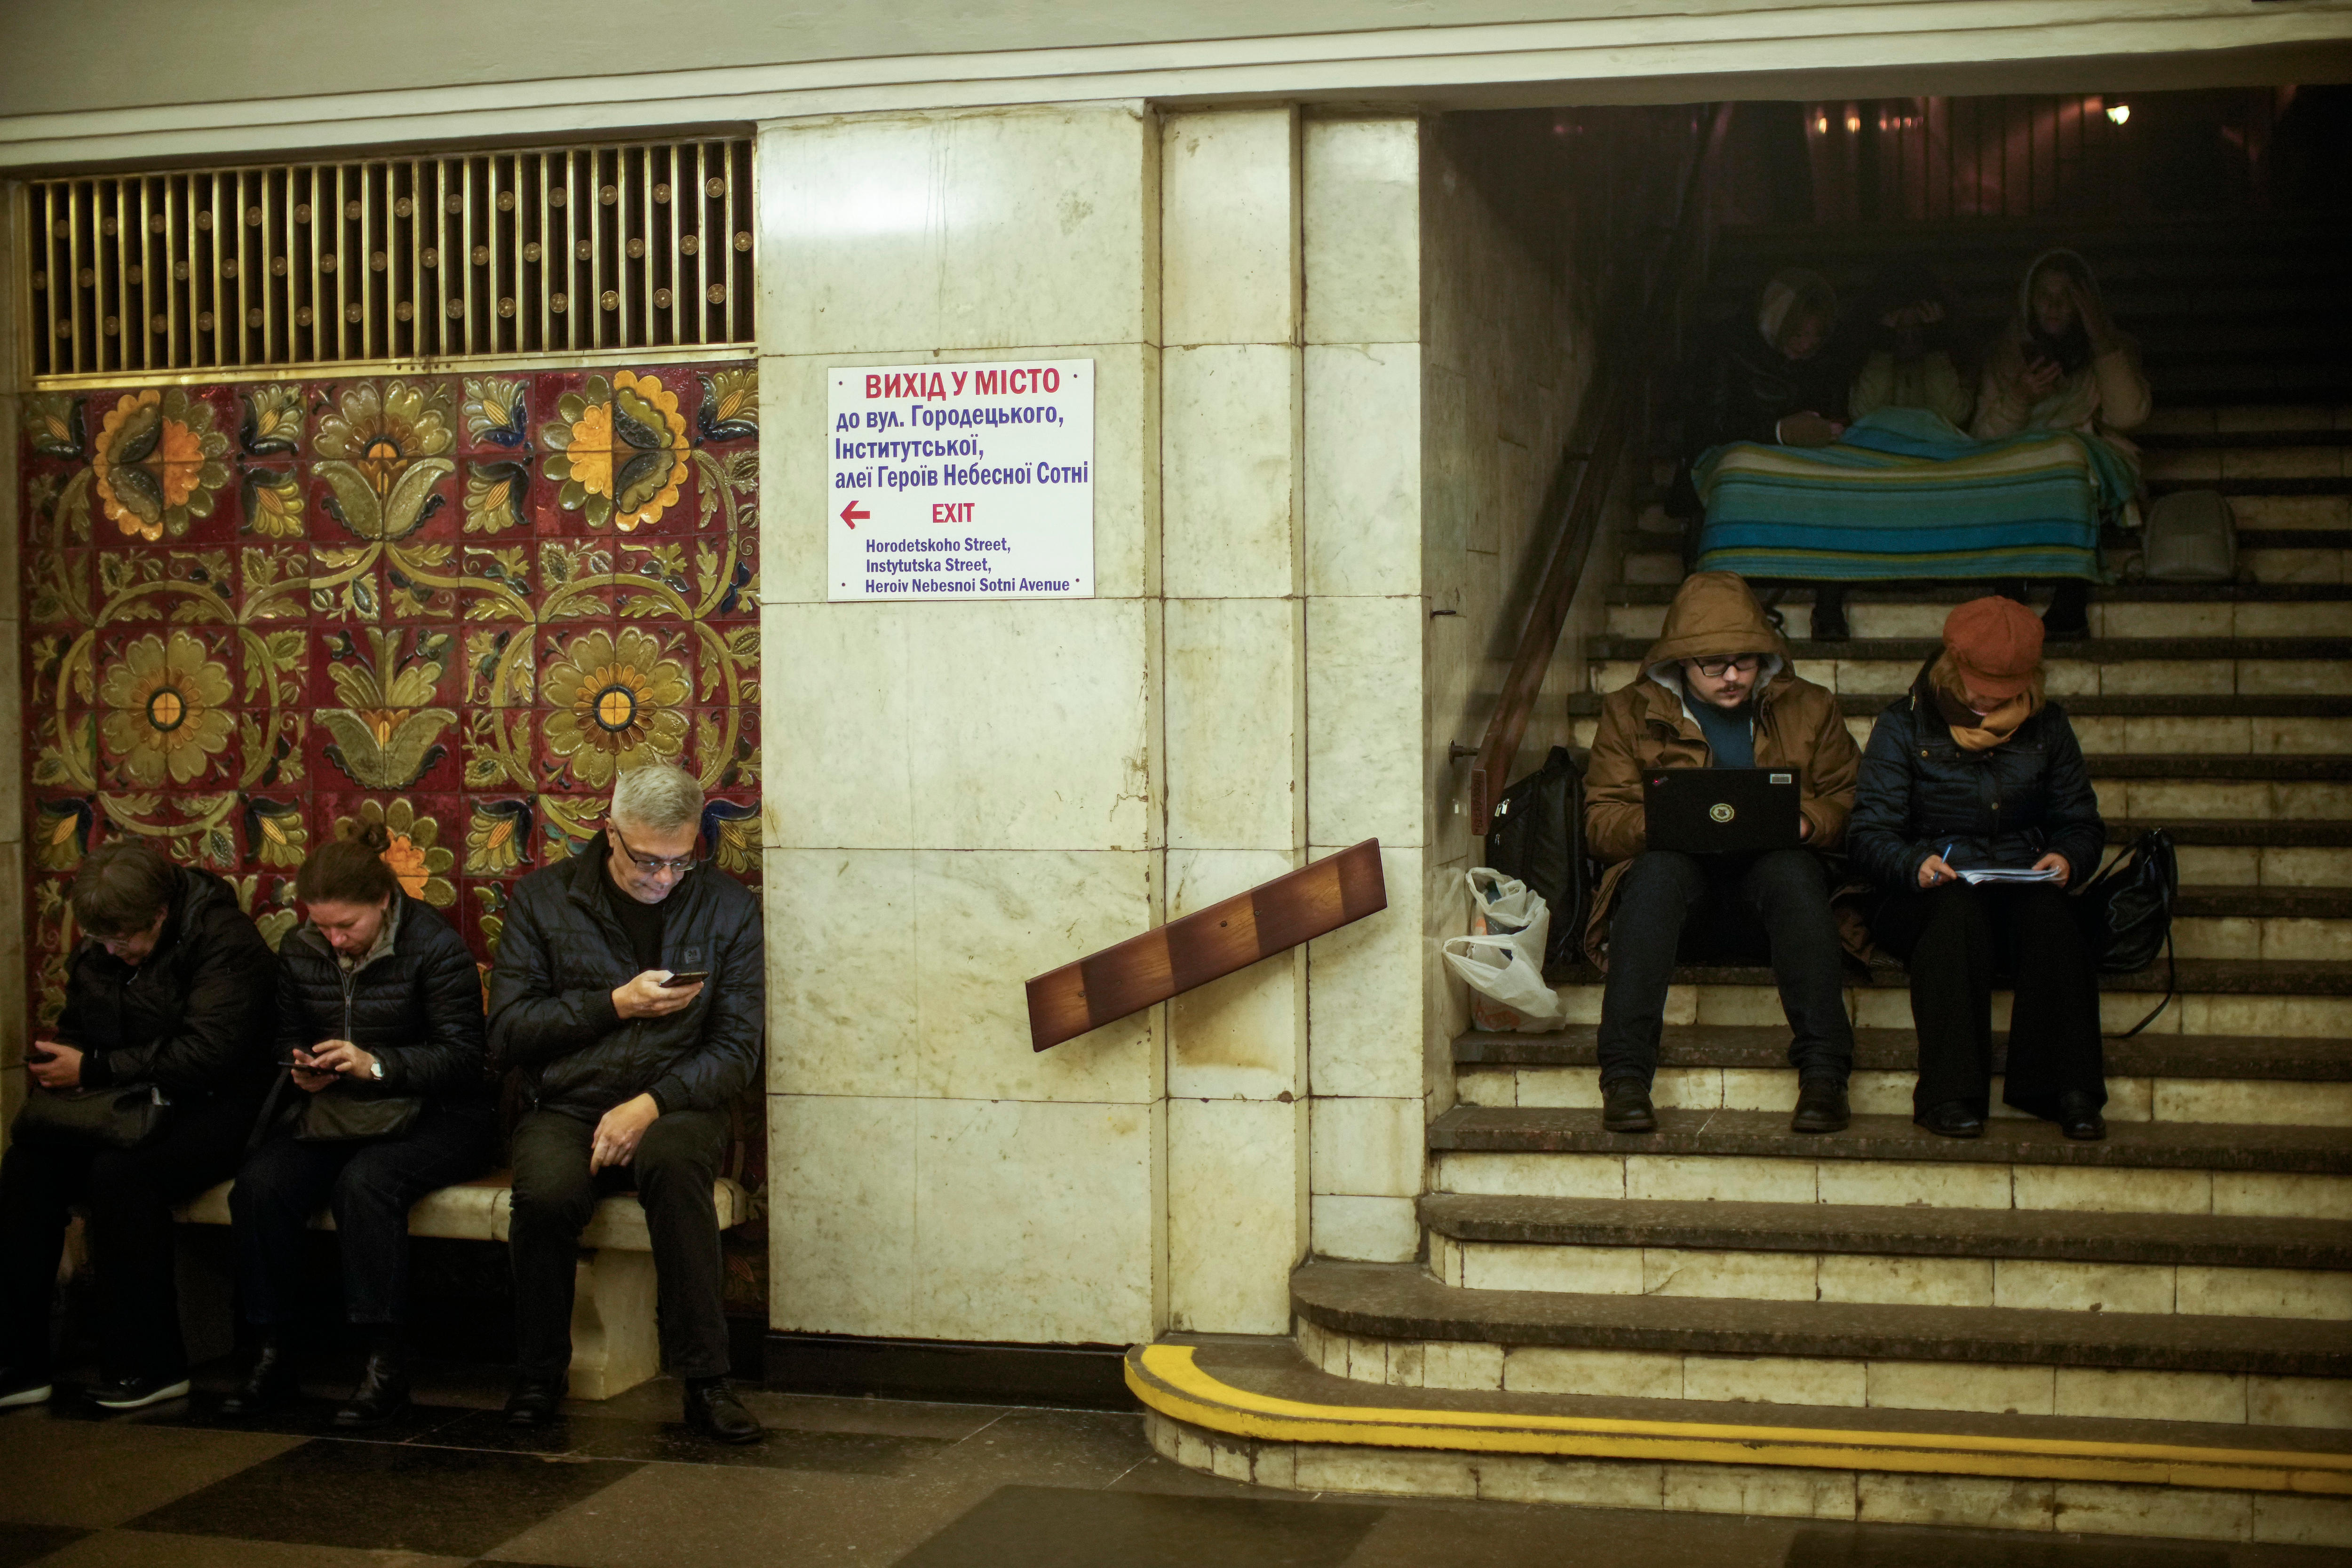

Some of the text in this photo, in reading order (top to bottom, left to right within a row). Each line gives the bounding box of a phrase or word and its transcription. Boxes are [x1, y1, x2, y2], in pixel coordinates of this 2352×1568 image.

[866, 367, 1060, 402] ВИХІД У МІСТО
[836, 405, 1064, 432] до вул. Городецького,
[835, 433, 984, 463] Інститутської,
[835, 461, 1088, 492] алеї Героїв Небесної Сотні
[932, 502, 975, 523] EXIT
[866, 537, 1011, 554] Horodetskoho Street,
[866, 557, 991, 576] Instytutska Street,
[866, 578, 1070, 593] Heroiv Nebesnoi Sotni Avenue
